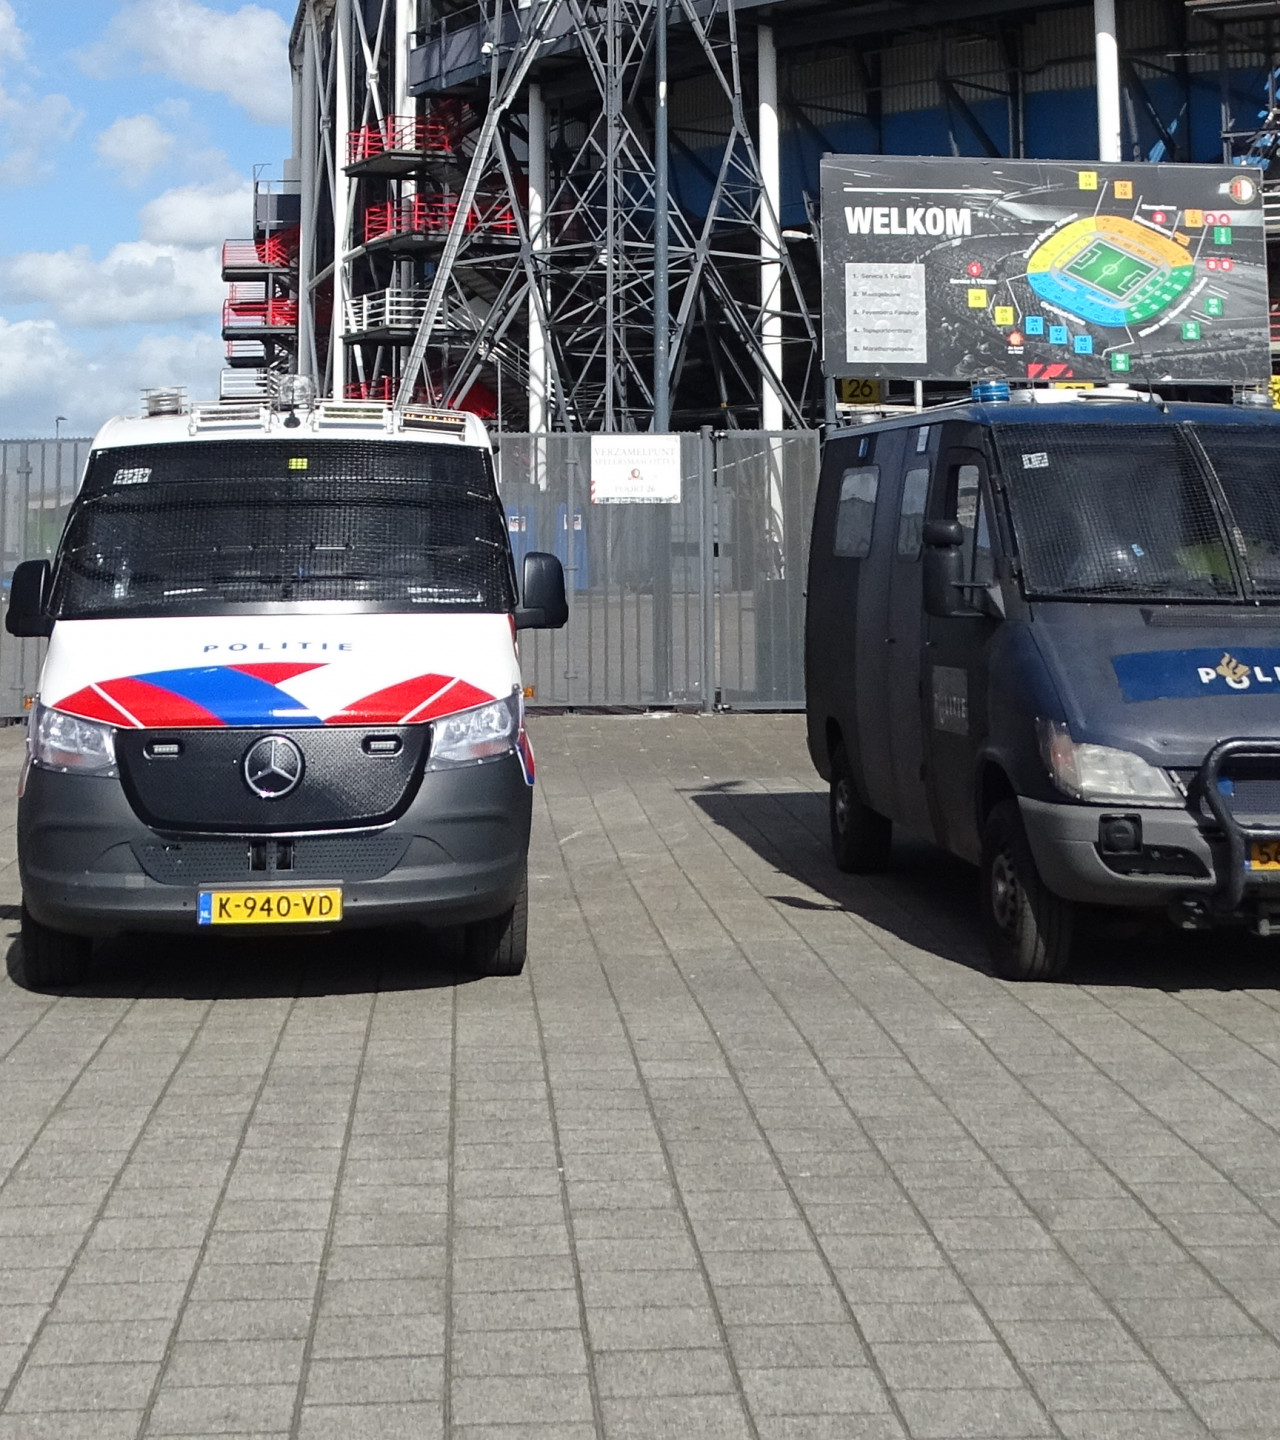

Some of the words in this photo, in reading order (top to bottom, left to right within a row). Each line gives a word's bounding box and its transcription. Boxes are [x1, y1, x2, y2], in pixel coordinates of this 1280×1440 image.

[844, 206, 972, 236] WELKOM
[848, 379, 872, 398] 26
[593, 447, 677, 457] VERZAMELPUNT
[197, 641, 353, 653] POLITIE
[218, 895, 333, 918] K-940-VD
